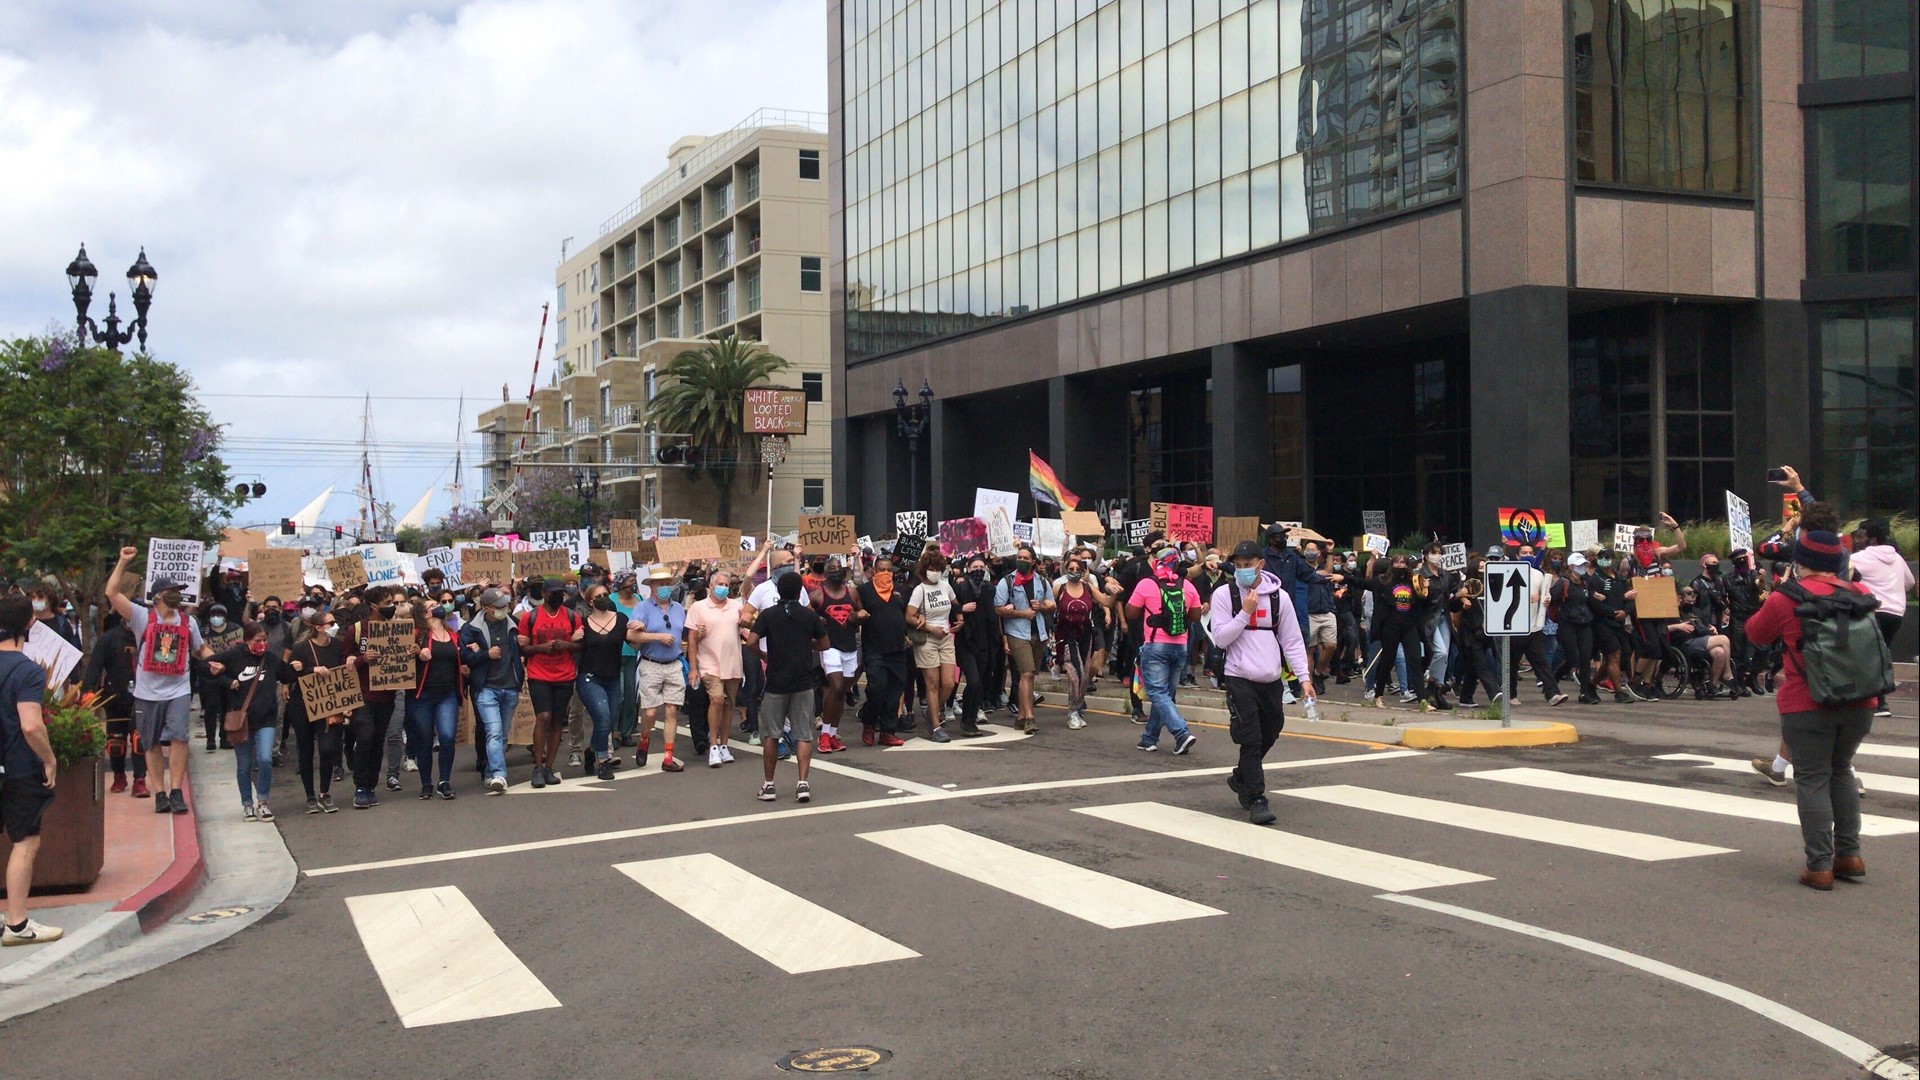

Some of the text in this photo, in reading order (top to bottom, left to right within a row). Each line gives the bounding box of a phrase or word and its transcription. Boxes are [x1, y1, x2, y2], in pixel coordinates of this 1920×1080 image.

[747, 391, 779, 403] WHITE
[753, 404, 792, 415] LOOTED
[754, 416, 784, 429] BLACK
[808, 517, 846, 529] FUCK
[897, 512, 927, 522] BLACK
[1179, 511, 1204, 523] FREE
[612, 520, 634, 528] BLACK
[613, 528, 635, 538] LIVES
[800, 529, 850, 545] TRUMP
[1131, 529, 1147, 537] LIV
[152, 541, 187, 550] Justice
[612, 538, 636, 548] MATTER
[901, 535, 921, 549] BLACK
[518, 551, 545, 561] BLACK
[1443, 545, 1461, 555] STICE
[153, 552, 198, 562] GEORGE
[338, 557, 351, 565] NO
[426, 551, 454, 568] END
[474, 552, 505, 563] JUSTICE
[1441, 553, 1464, 568] PEACE
[153, 562, 194, 571] FLOYD:
[329, 561, 360, 574] JUSTICE
[443, 561, 461, 575] ICE
[520, 560, 567, 575] MATTER
[171, 572, 196, 583] Killer
[342, 571, 355, 579] NO
[333, 576, 363, 590] PEACE
[391, 622, 413, 635] ABOUT
[302, 668, 350, 690] WHITE
[306, 680, 356, 702] SILENCE
[309, 693, 363, 717] VIOLENCE
